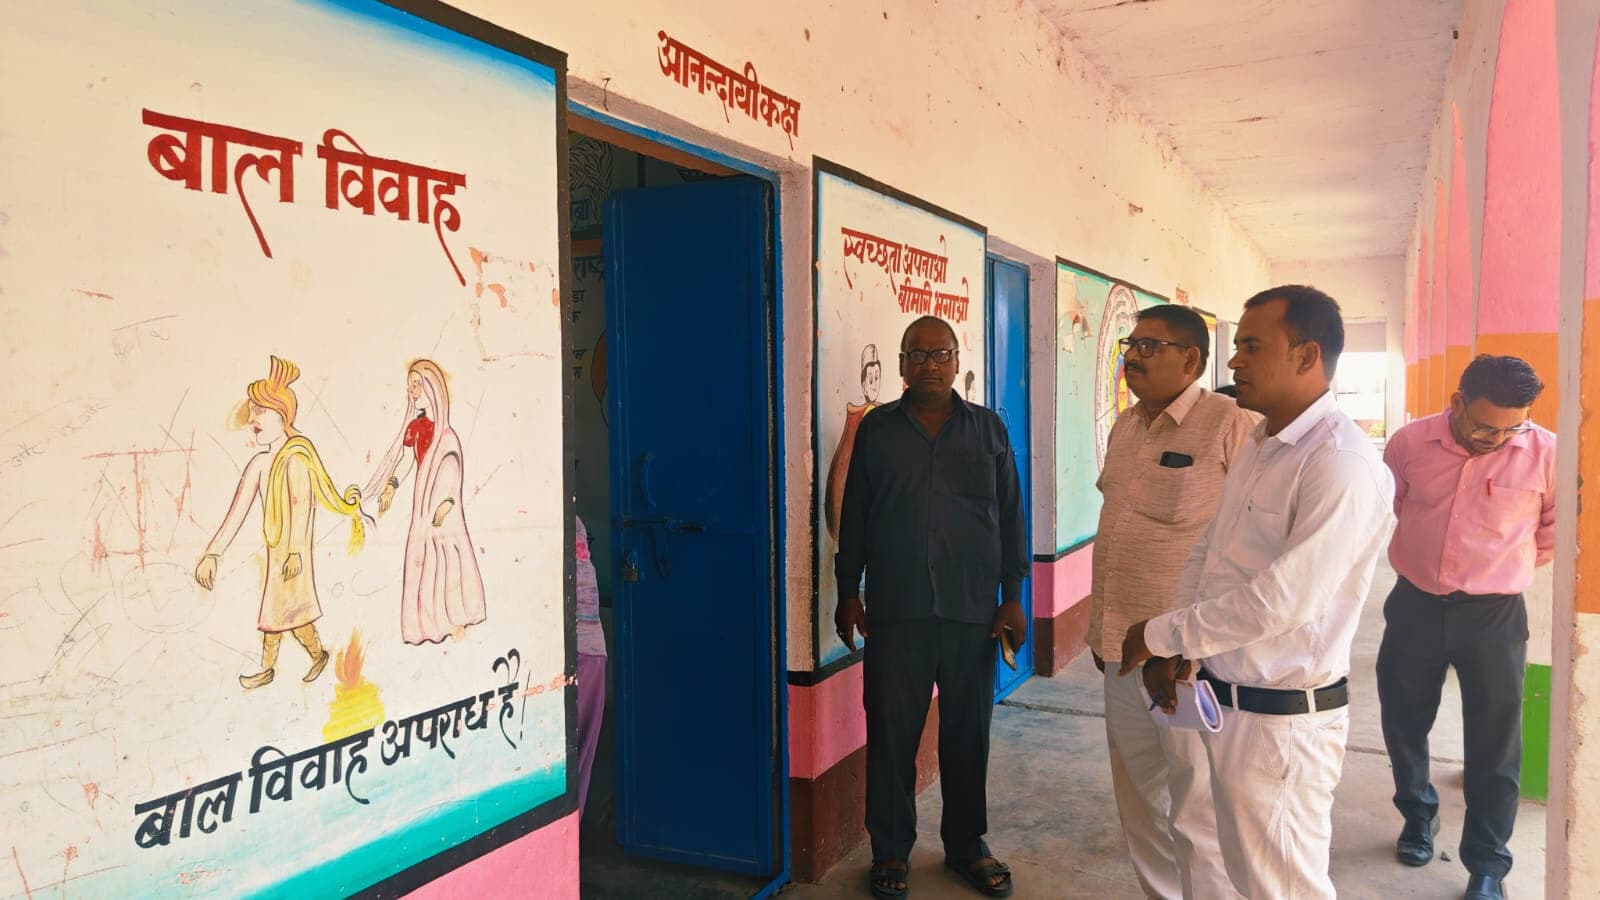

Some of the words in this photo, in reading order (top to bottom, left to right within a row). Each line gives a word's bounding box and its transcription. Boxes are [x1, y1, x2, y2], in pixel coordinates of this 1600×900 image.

[142, 108, 303, 258] बाल
[317, 128, 467, 287] विवाह
[134, 771, 243, 849] बाल
[247, 727, 377, 814] विवाह
[380, 689, 495, 766] अपराध
